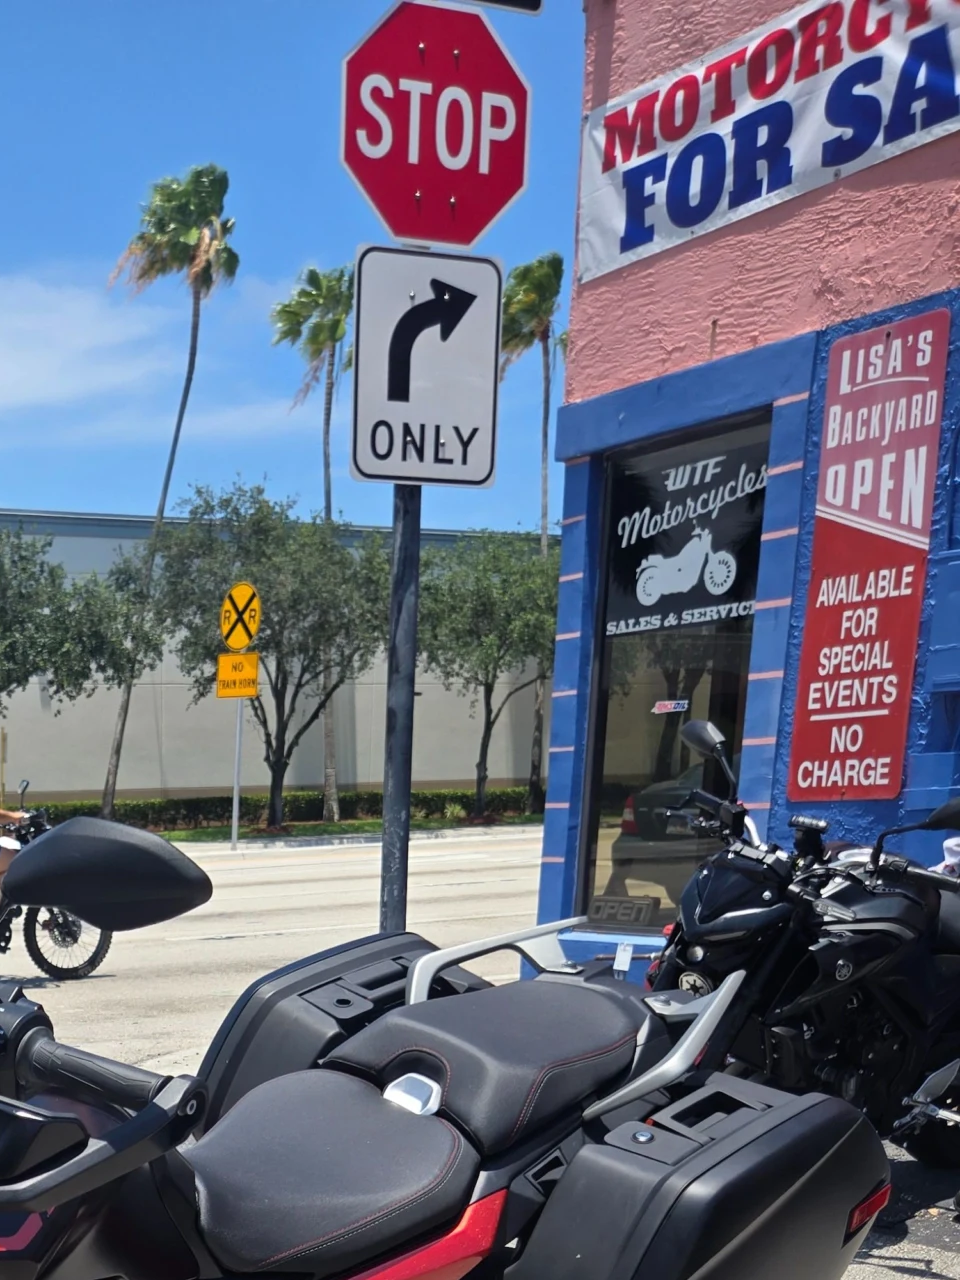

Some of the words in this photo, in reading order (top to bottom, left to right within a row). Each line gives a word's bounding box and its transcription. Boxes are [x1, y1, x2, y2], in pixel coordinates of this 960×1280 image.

[356, 74, 516, 175] STOP
[620, 100, 794, 254] FOR
[839, 330, 933, 395] LISA'S
[370, 420, 479, 465] ONLY
[662, 456, 726, 491] WTF
[617, 463, 768, 548] Motorcycles
[825, 446, 927, 539] OPEN
[816, 566, 915, 608] AVAILABLE
[606, 615, 661, 635] SALES
[664, 612, 678, 627] &
[840, 607, 878, 640] FOR
[232, 662, 244, 672] NO
[818, 641, 893, 676] SPECIAL
[808, 675, 897, 710] EVENTS
[830, 724, 863, 753] NO
[797, 757, 891, 788] CHARGE
[591, 901, 651, 926] OPEN
